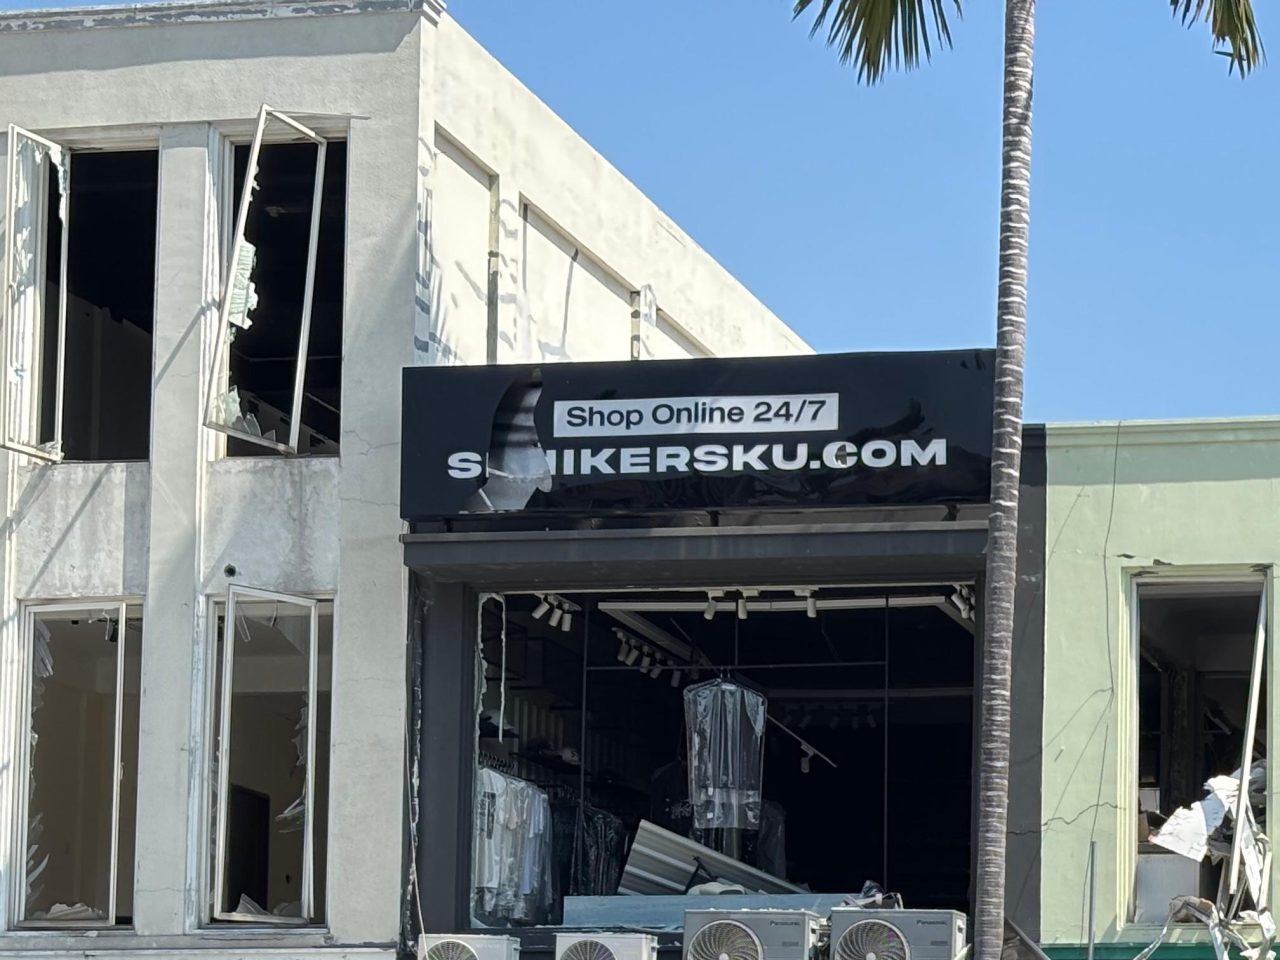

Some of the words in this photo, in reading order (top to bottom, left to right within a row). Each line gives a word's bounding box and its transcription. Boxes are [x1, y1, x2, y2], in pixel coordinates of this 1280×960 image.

[566, 406, 644, 430] Shop
[651, 402, 745, 425] Online
[753, 400, 827, 423] 24/7
